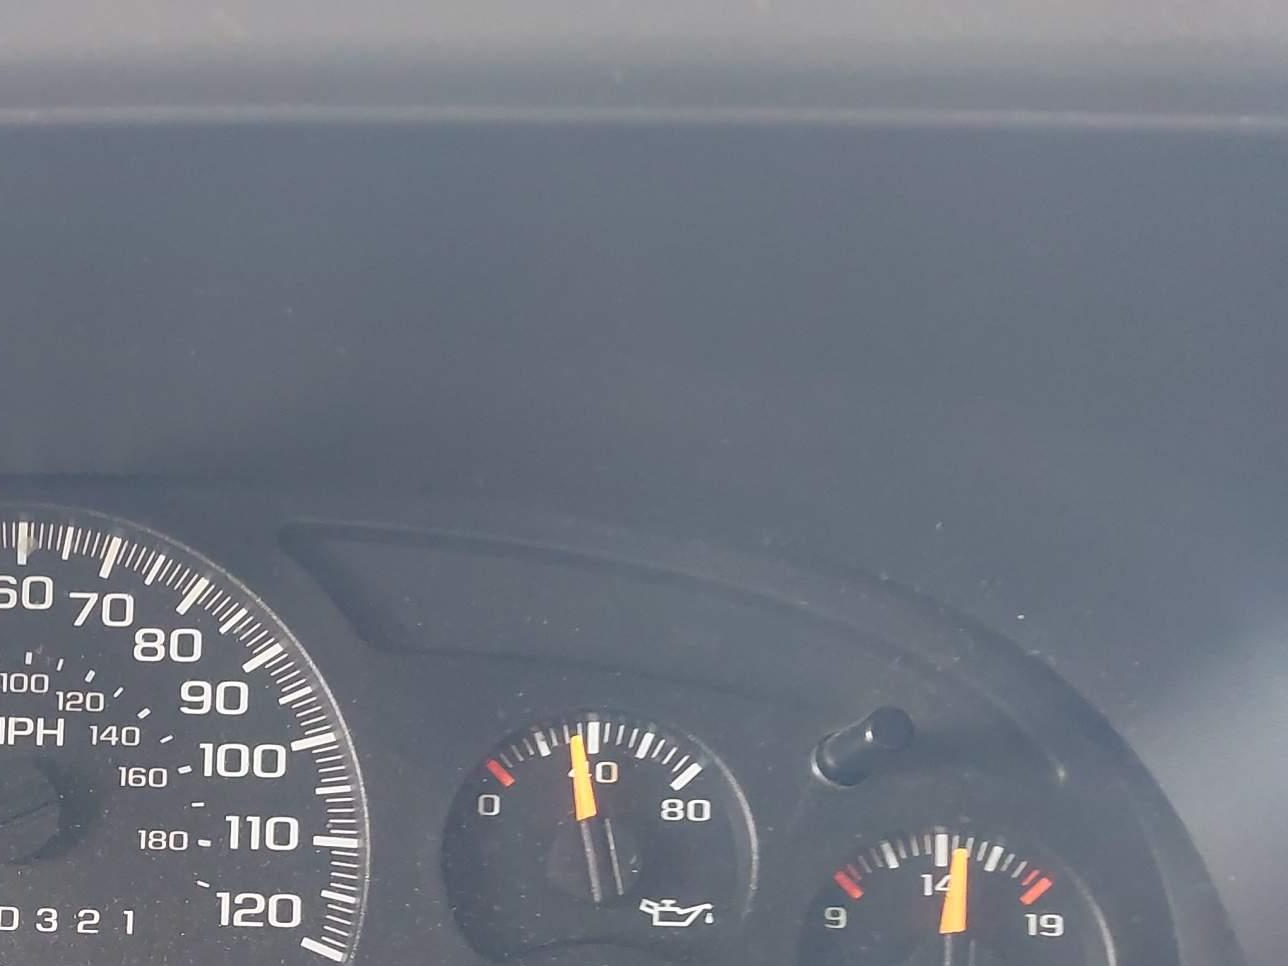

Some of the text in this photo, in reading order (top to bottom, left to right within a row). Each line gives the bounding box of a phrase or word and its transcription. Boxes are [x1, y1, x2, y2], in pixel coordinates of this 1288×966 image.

[69, 592, 135, 627] 70
[133, 628, 202, 662] 80
[0, 672, 49, 693] 100
[56, 691, 105, 712] 120
[180, 680, 249, 715] 90
[89, 725, 141, 746] 140
[199, 742, 287, 778] 100
[118, 766, 168, 788] 160
[477, 793, 501, 817] 0
[660, 798, 712, 822] 80
[137, 829, 189, 851] 180
[225, 815, 300, 851] 110
[215, 891, 302, 928] 120
[824, 907, 848, 928] 9
[1025, 913, 1064, 937] 19
